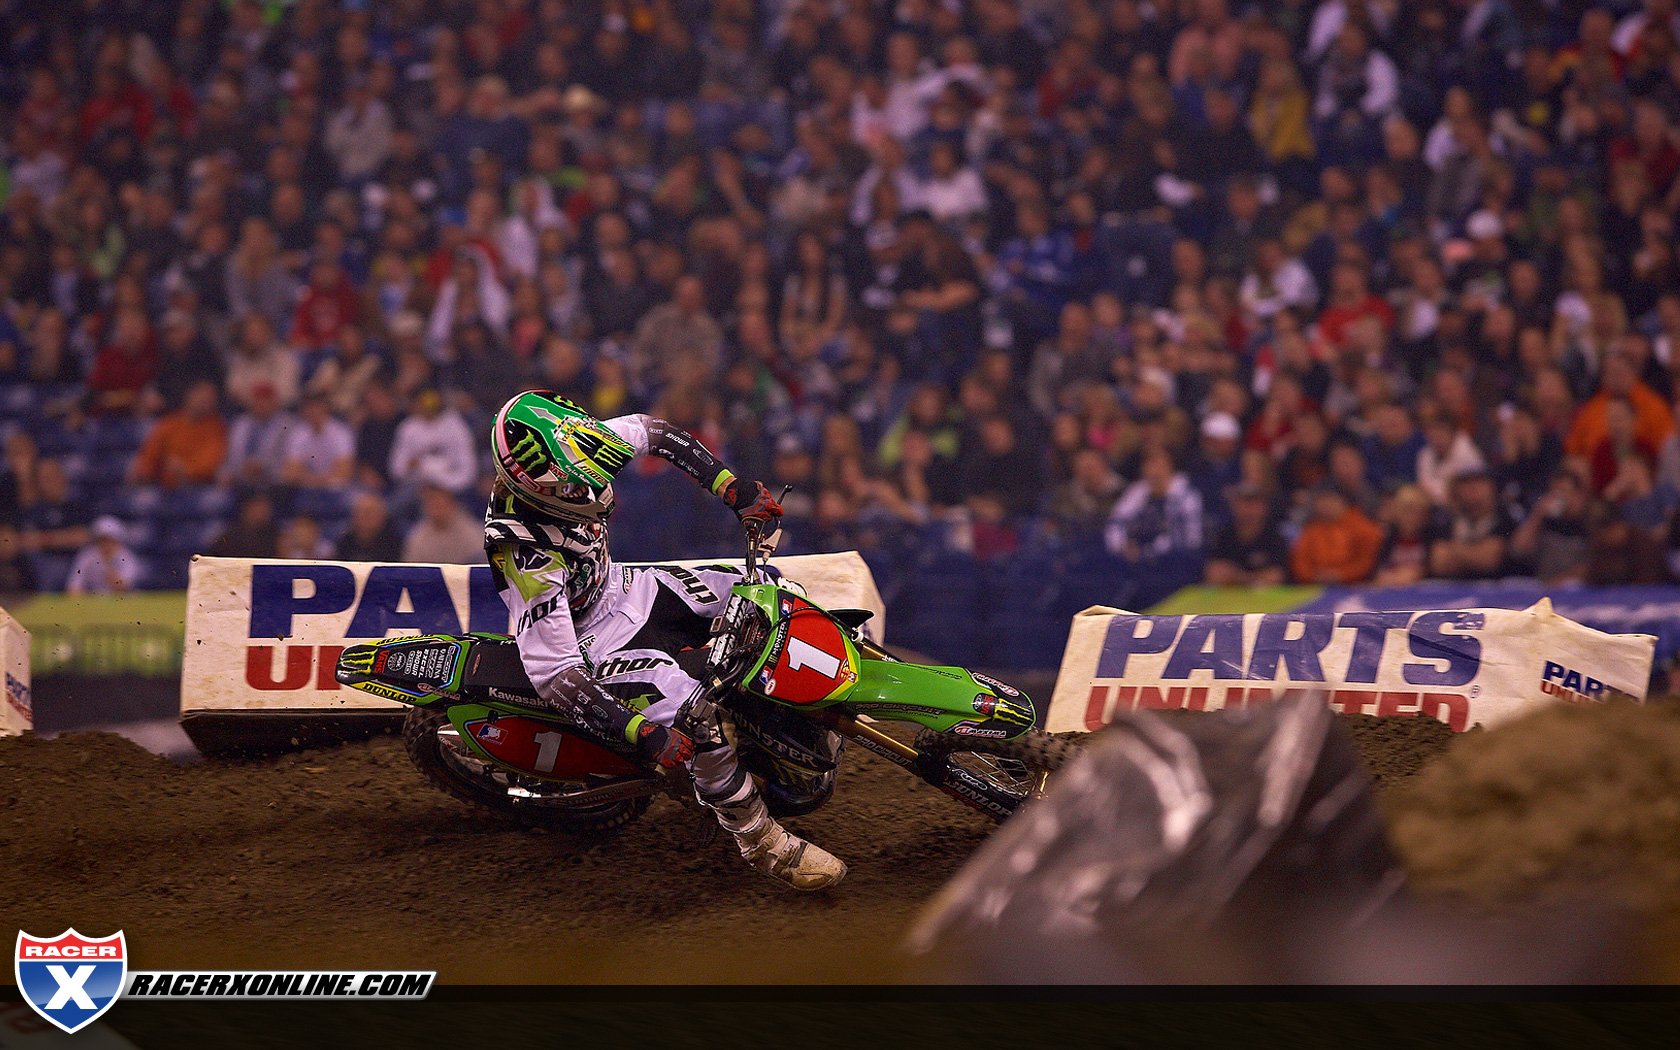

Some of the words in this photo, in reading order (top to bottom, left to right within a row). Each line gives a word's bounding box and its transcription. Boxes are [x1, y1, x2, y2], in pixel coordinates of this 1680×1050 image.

[665, 432, 690, 448] SHOWA
[550, 463, 569, 480] VANS
[517, 586, 565, 637] thor
[374, 649, 390, 674] VANS
[786, 635, 842, 680] 1
[1094, 611, 1487, 687] PARTS
[412, 650, 423, 676] SHOWA
[596, 656, 674, 681] thor
[362, 682, 418, 704] DUNLOP
[488, 687, 549, 708] Kawasaki
[533, 731, 563, 773] 1
